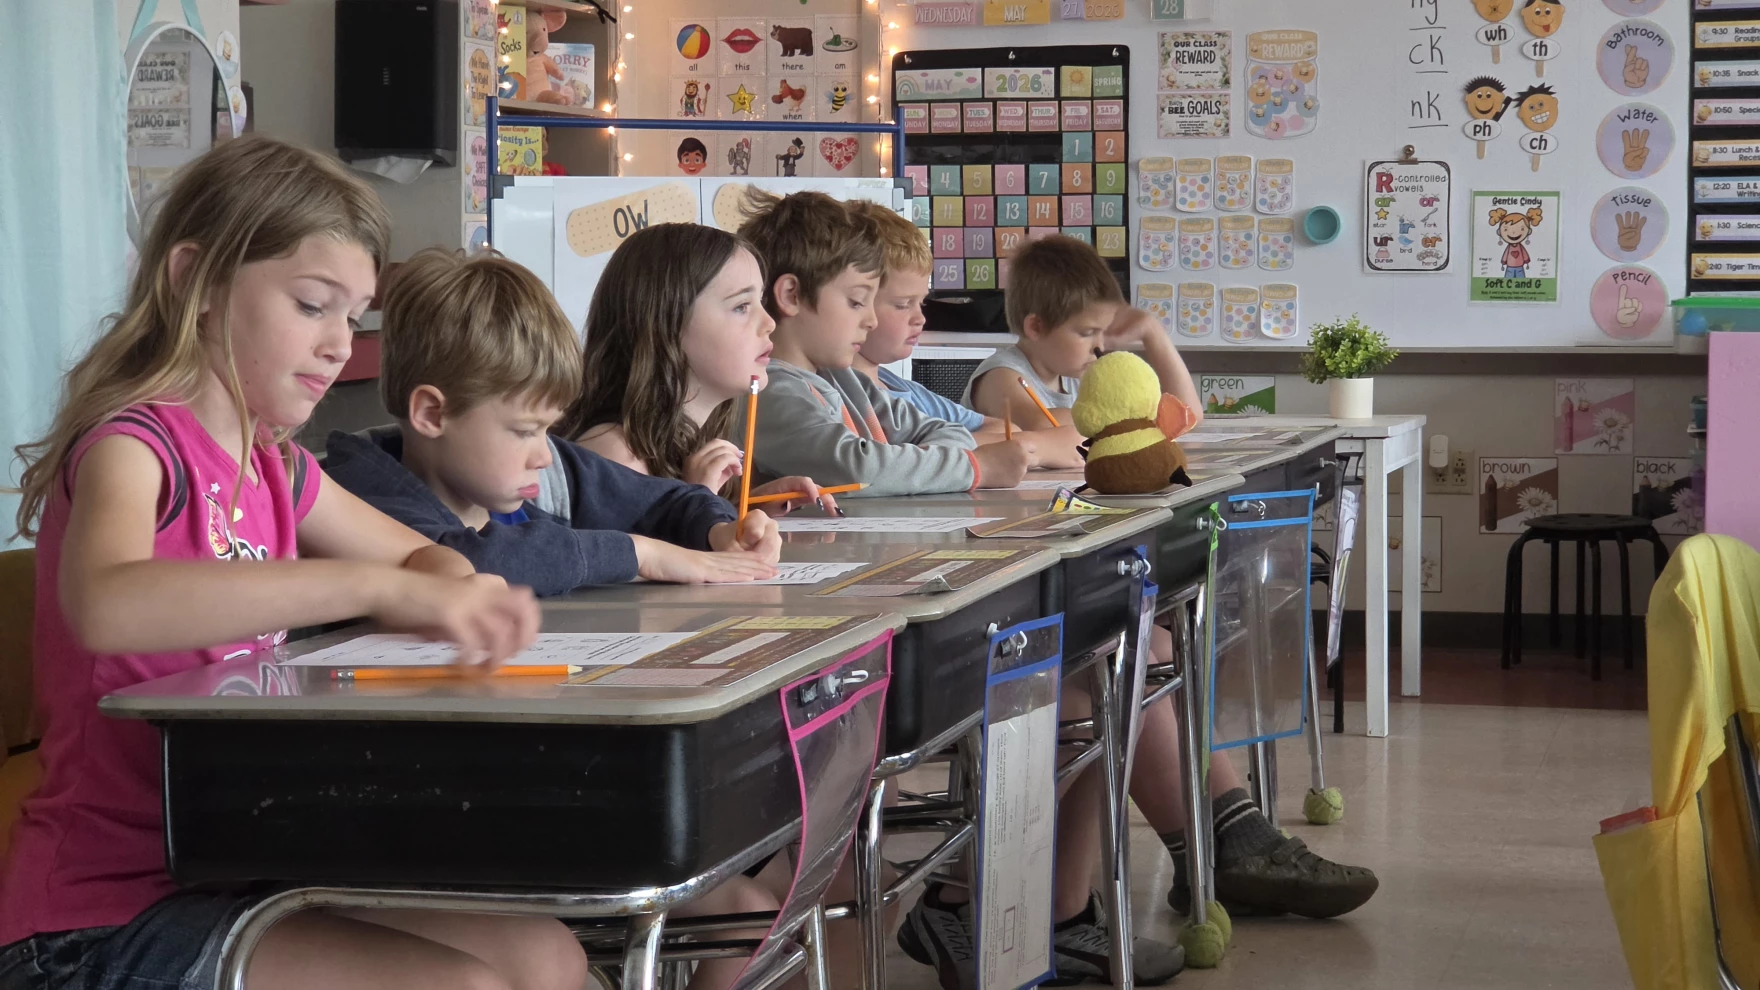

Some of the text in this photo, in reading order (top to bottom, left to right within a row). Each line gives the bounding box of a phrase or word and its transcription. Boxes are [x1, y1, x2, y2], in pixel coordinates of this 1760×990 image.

[915, 7, 973, 23] WEDNESDAY
[1004, 5, 1026, 22] MAY
[1086, 4, 1120, 17] 2026
[1161, 0, 1178, 14] 28
[1485, 26, 1507, 42] wh
[1606, 25, 1664, 49] Bathroom
[501, 39, 522, 55] Socks
[1262, 43, 1304, 58] REWARD
[1532, 41, 1548, 57] th
[554, 54, 590, 67] ORRY
[1175, 50, 1216, 65] REWARD
[689, 63, 698, 71] all
[735, 63, 750, 71] this
[782, 63, 804, 71] there
[925, 79, 953, 91] MAY
[996, 74, 1042, 92] 2026
[1093, 76, 1122, 87] SPRING
[1101, 106, 1116, 114] SAT.
[1187, 101, 1221, 115] GOALS
[1617, 108, 1658, 124] Water
[1065, 118, 1087, 126] FRIDAY
[1473, 121, 1492, 137] ph
[1074, 139, 1080, 156] 1
[1105, 139, 1114, 156] 2
[1529, 135, 1548, 150] ch
[1732, 146, 1753, 154] Lunch
[940, 172, 950, 188] 4
[973, 171, 982, 188] 5
[1006, 171, 1015, 188] 6
[1039, 171, 1048, 188] 7
[1072, 170, 1082, 187] 8
[1106, 170, 1116, 187] 9
[1394, 185, 1424, 193] vowels
[1375, 197, 1396, 207] ar
[1419, 197, 1440, 207] or
[1492, 197, 1542, 208] Gentle Cindy
[1611, 194, 1652, 207] Tissue
[912, 204, 922, 220] 0
[943, 203, 953, 220] 11
[973, 203, 986, 220] 12
[1005, 202, 1020, 220] 13
[1035, 202, 1050, 219] 14
[1070, 202, 1084, 218] 15
[1100, 201, 1114, 218] 16
[613, 199, 648, 238] OW
[941, 234, 956, 251] 18
[972, 234, 984, 250] 19
[1001, 232, 1019, 249] 20
[1102, 232, 1120, 249] 23
[1373, 236, 1394, 246] ur
[1421, 237, 1442, 248] er
[939, 265, 957, 282] 25
[972, 265, 989, 282] 26
[1726, 264, 1745, 272] Tiger
[1485, 279, 1542, 289] Soft C and G
[1612, 270, 1652, 286] Pencil
[1201, 377, 1244, 393] green
[1557, 380, 1587, 397] pink
[1482, 460, 1531, 474] brown
[1636, 460, 1676, 474] black
